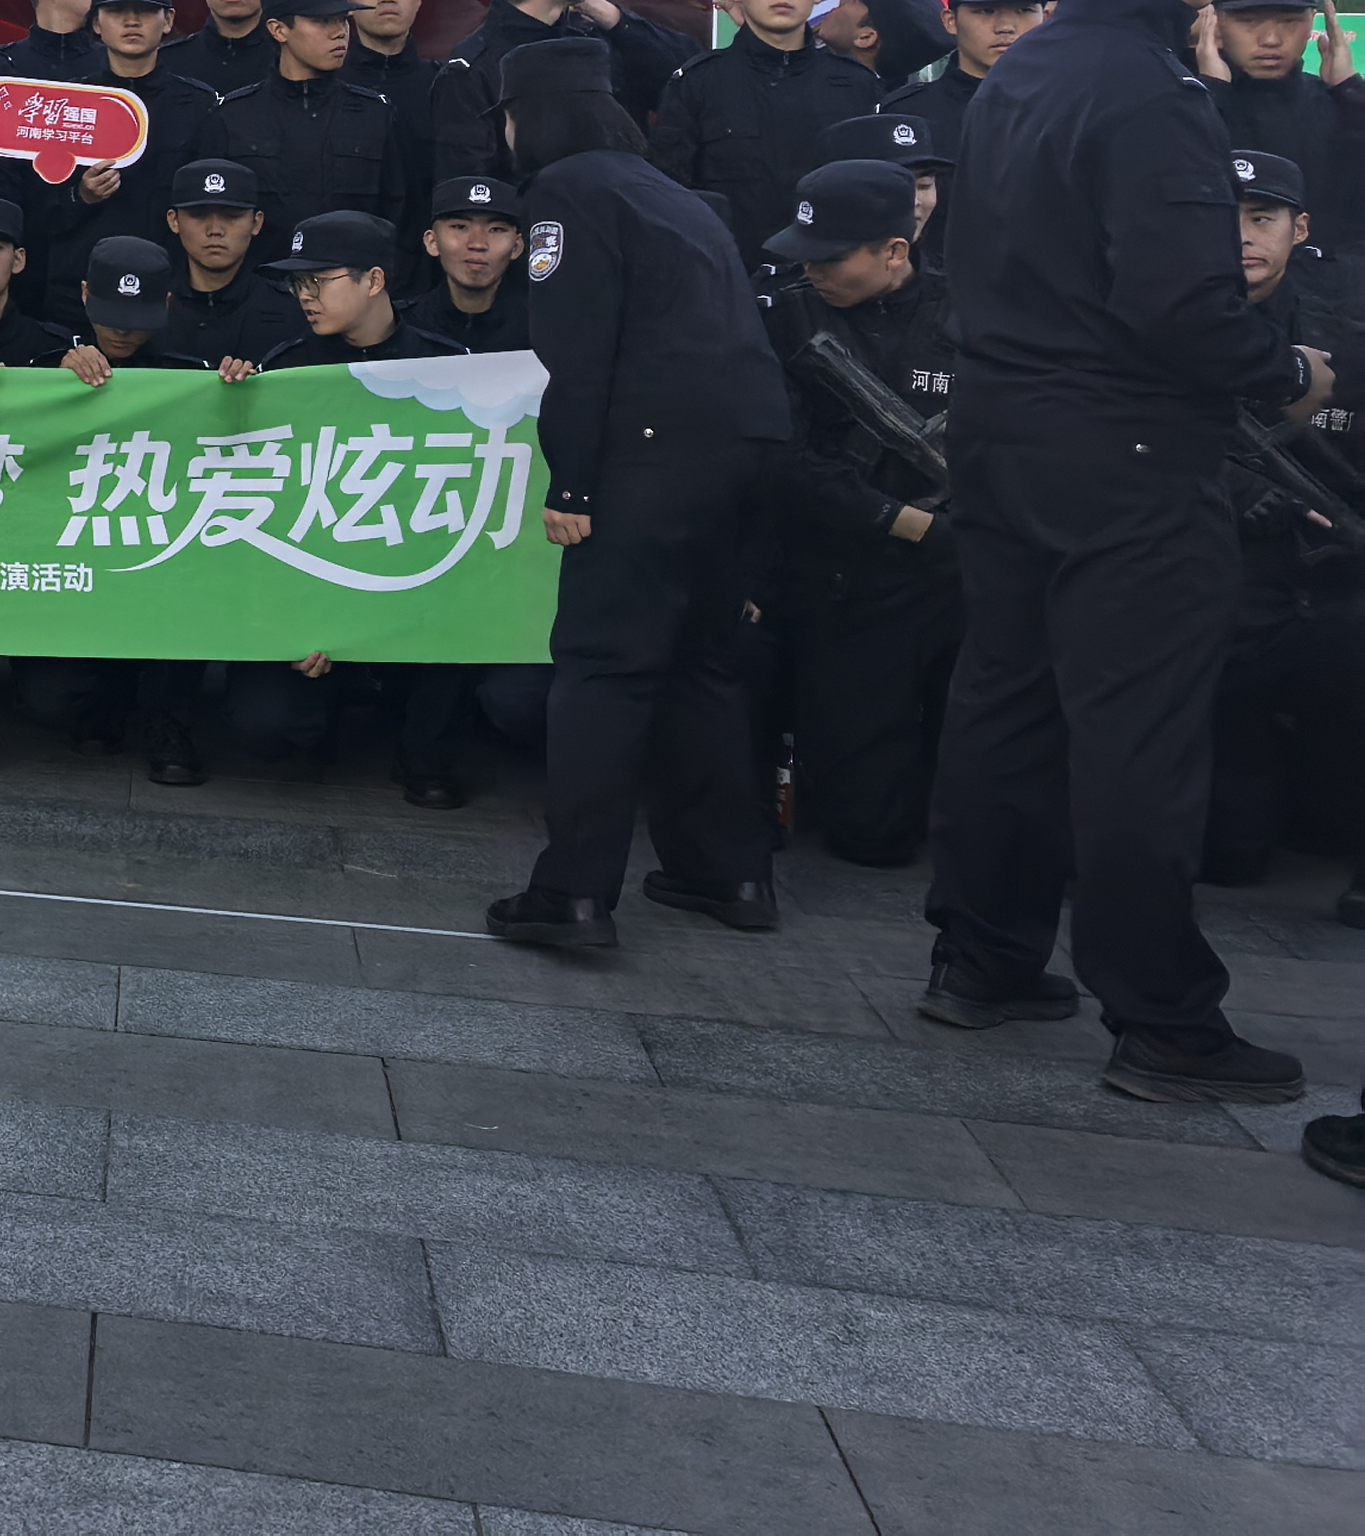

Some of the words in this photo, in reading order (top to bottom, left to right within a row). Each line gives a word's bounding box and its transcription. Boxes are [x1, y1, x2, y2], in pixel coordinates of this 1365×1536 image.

[16, 125, 94, 145] 河南学习平台
[56, 423, 533, 592] 热爱炫动
